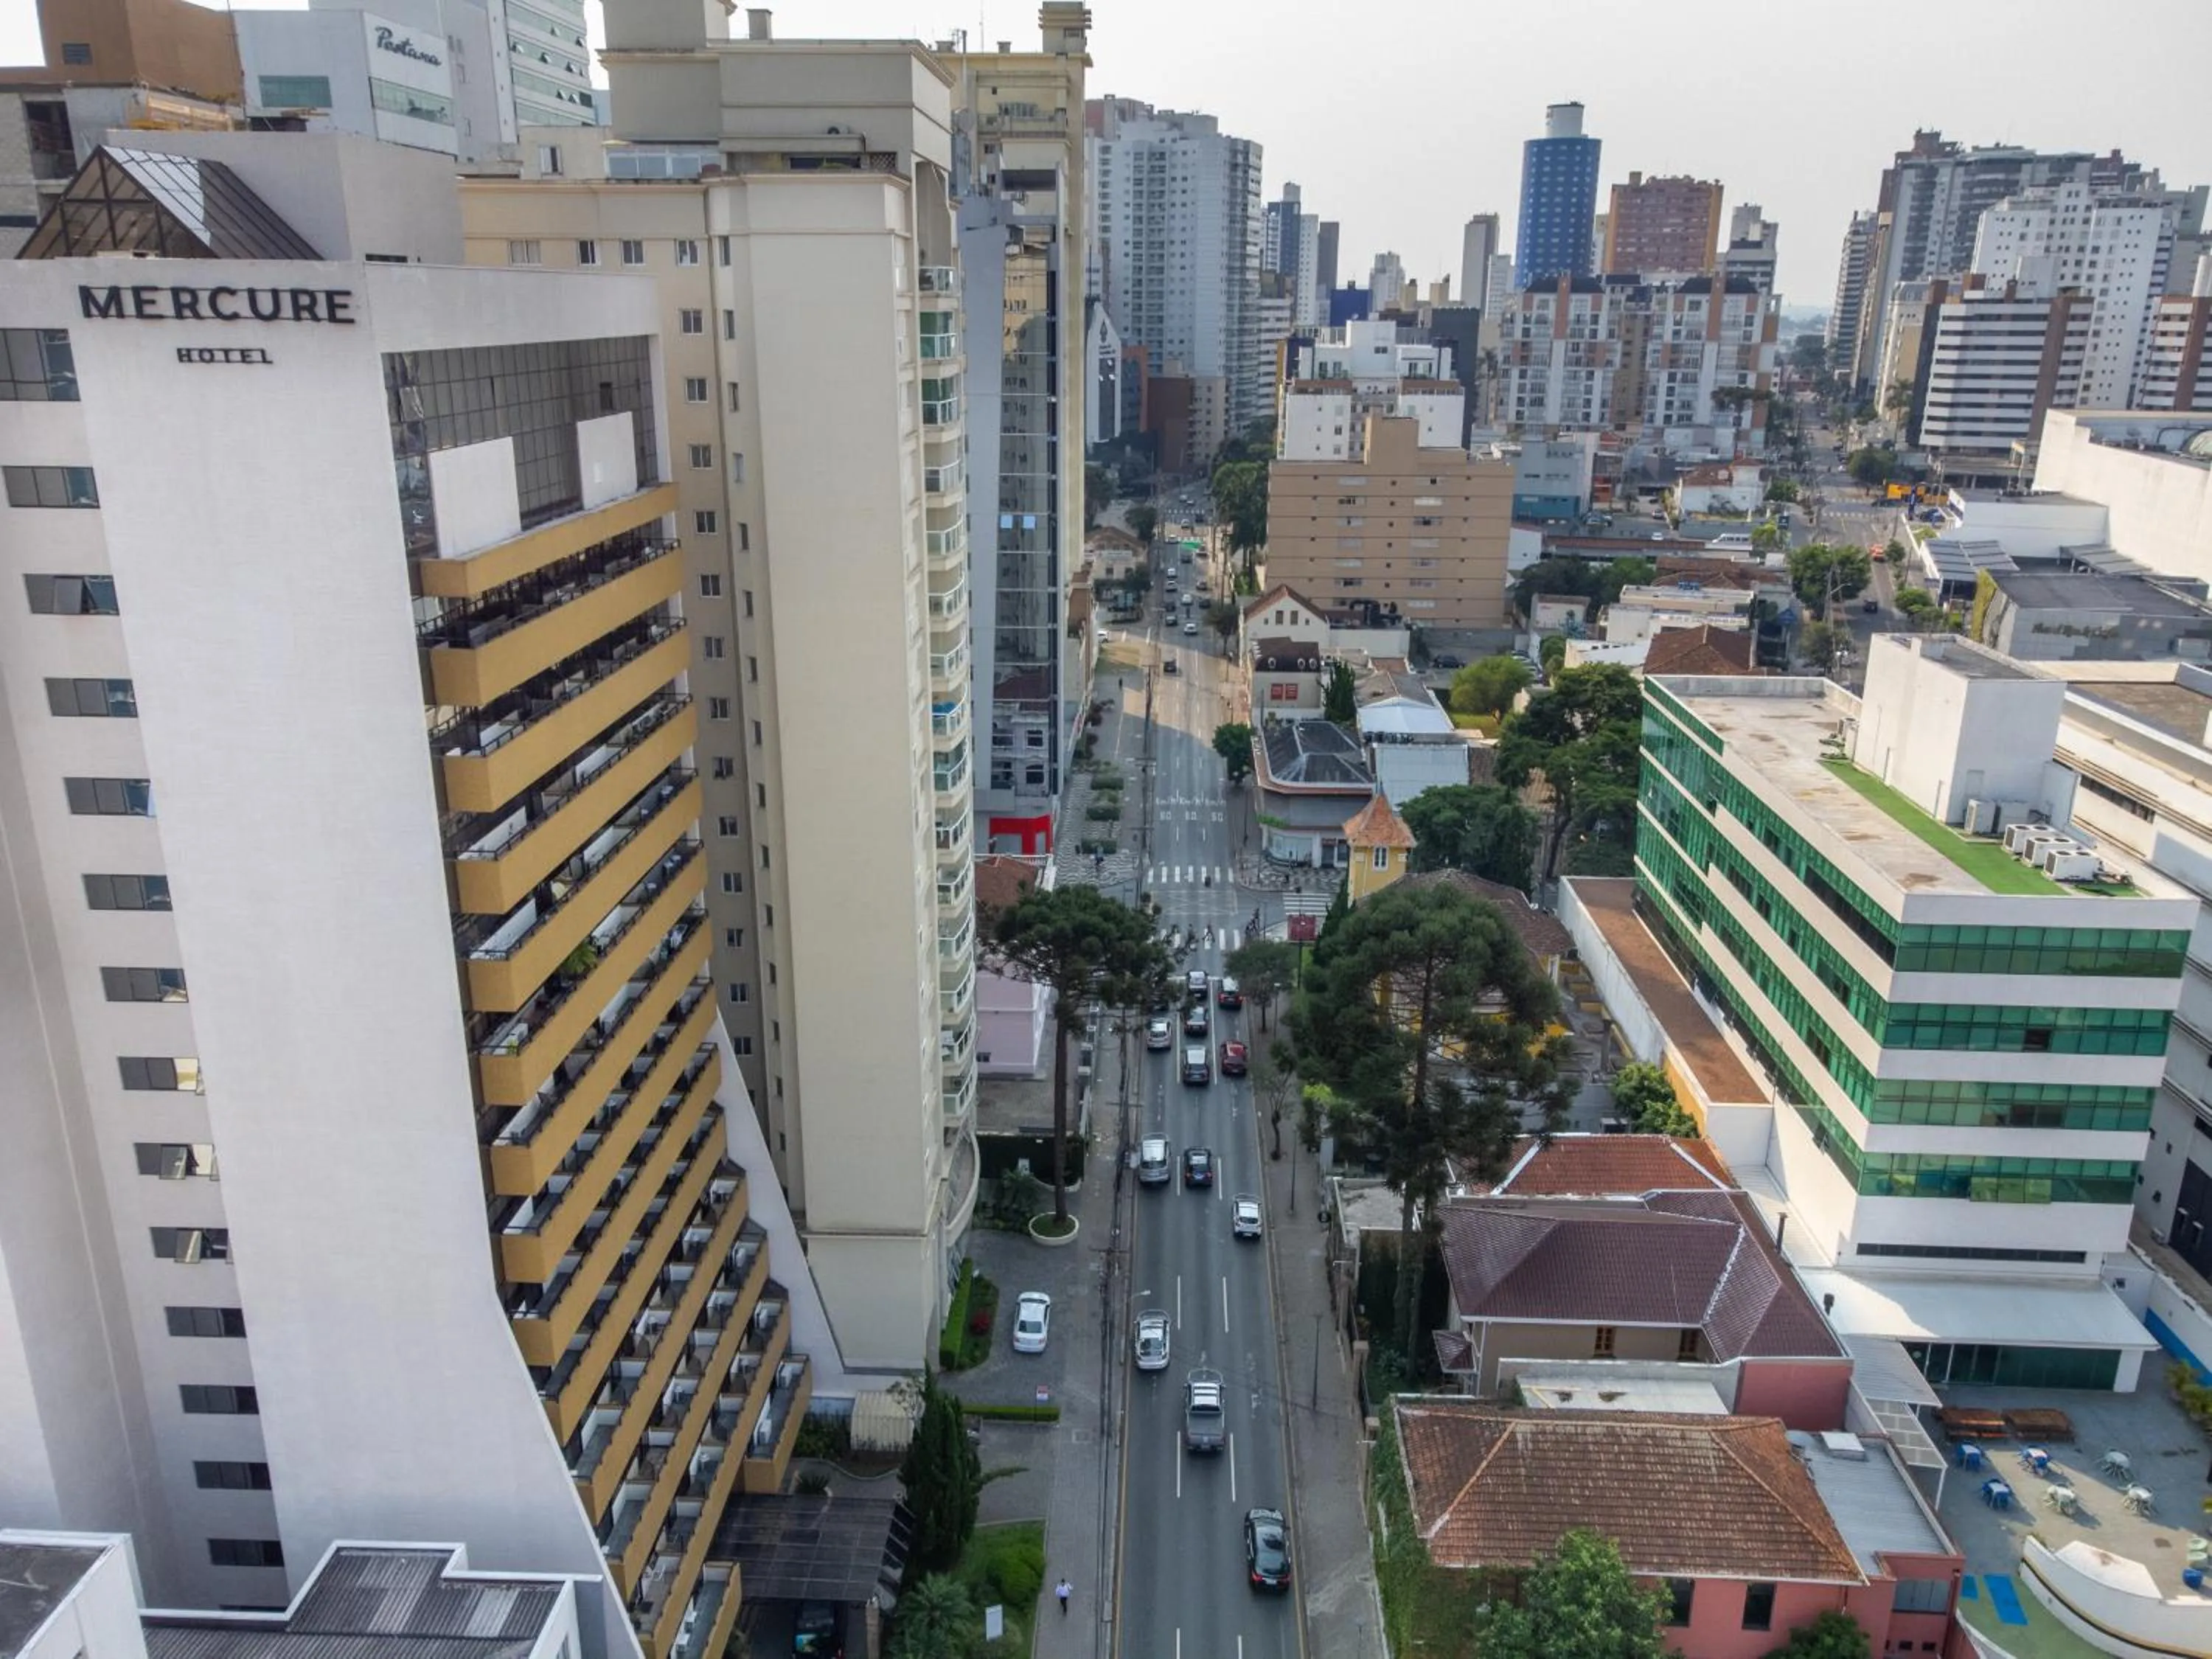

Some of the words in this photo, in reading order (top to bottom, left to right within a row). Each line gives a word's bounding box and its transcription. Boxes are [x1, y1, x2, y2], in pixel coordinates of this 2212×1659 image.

[375, 26, 442, 66] Pestana
[78, 284, 356, 324] MERCURE
[176, 347, 274, 364] HOTEL
